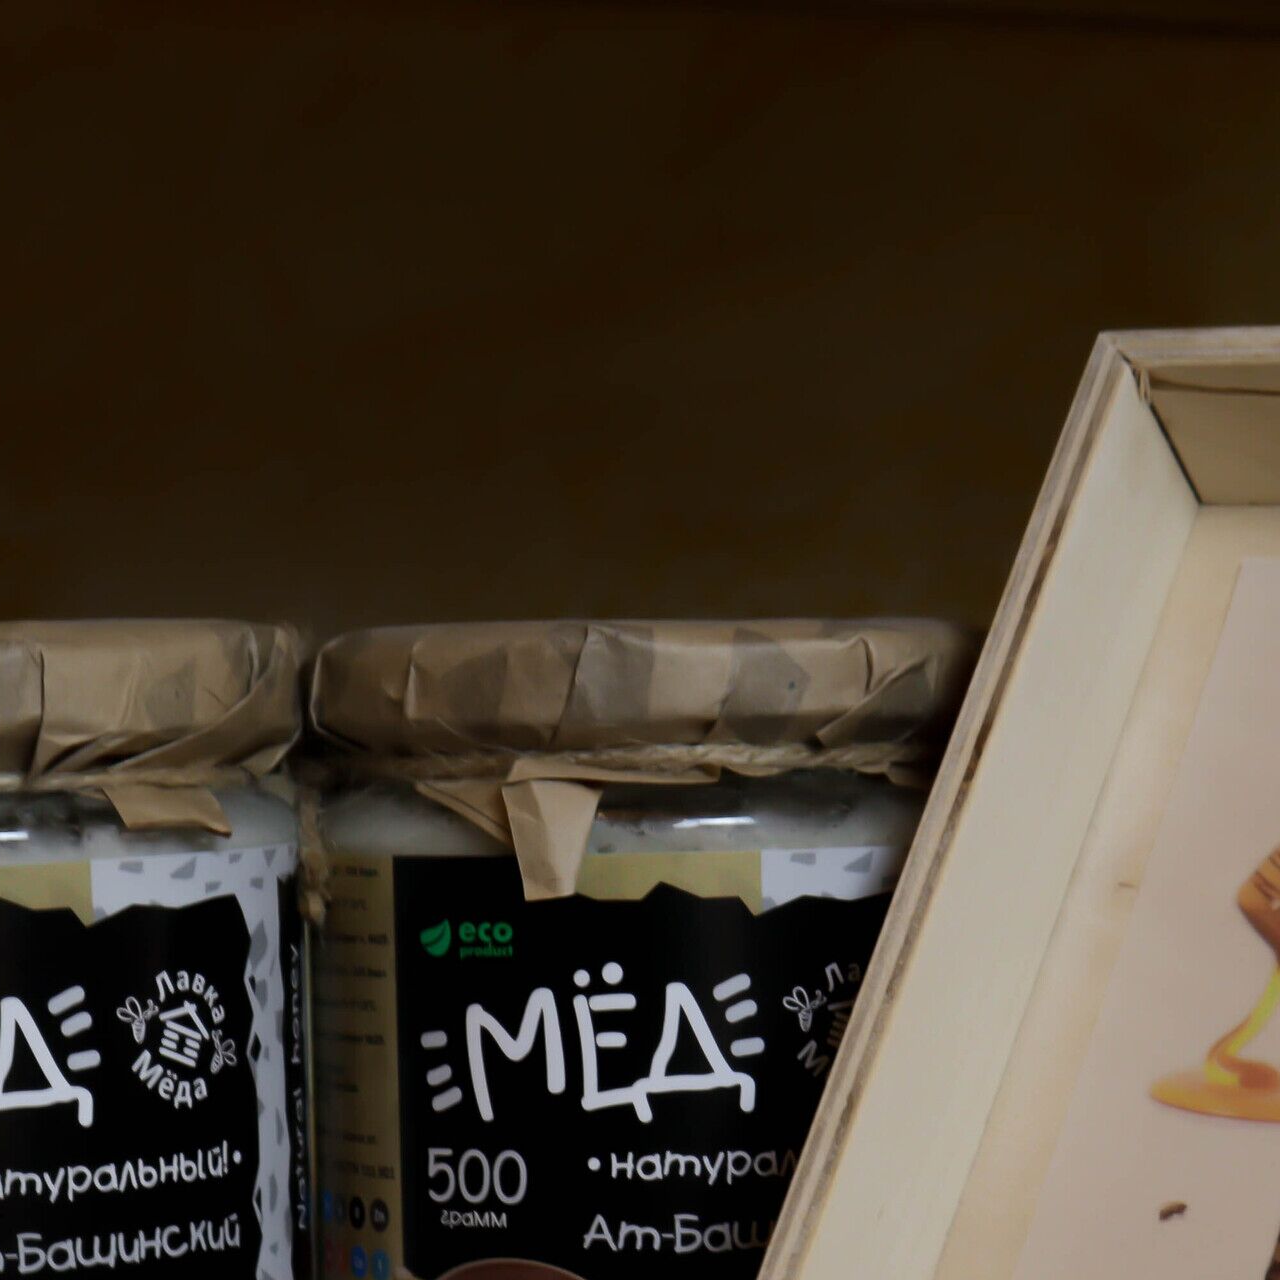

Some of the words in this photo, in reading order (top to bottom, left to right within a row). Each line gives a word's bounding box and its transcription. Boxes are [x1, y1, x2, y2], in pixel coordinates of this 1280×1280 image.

[458, 919, 514, 945] eco
[153, 969, 226, 1026] Лавка
[465, 960, 757, 1124] МЁД
[130, 1048, 209, 1110] Мёда
[426, 1147, 528, 1206] 500
[440, 1209, 509, 1230] грамм
